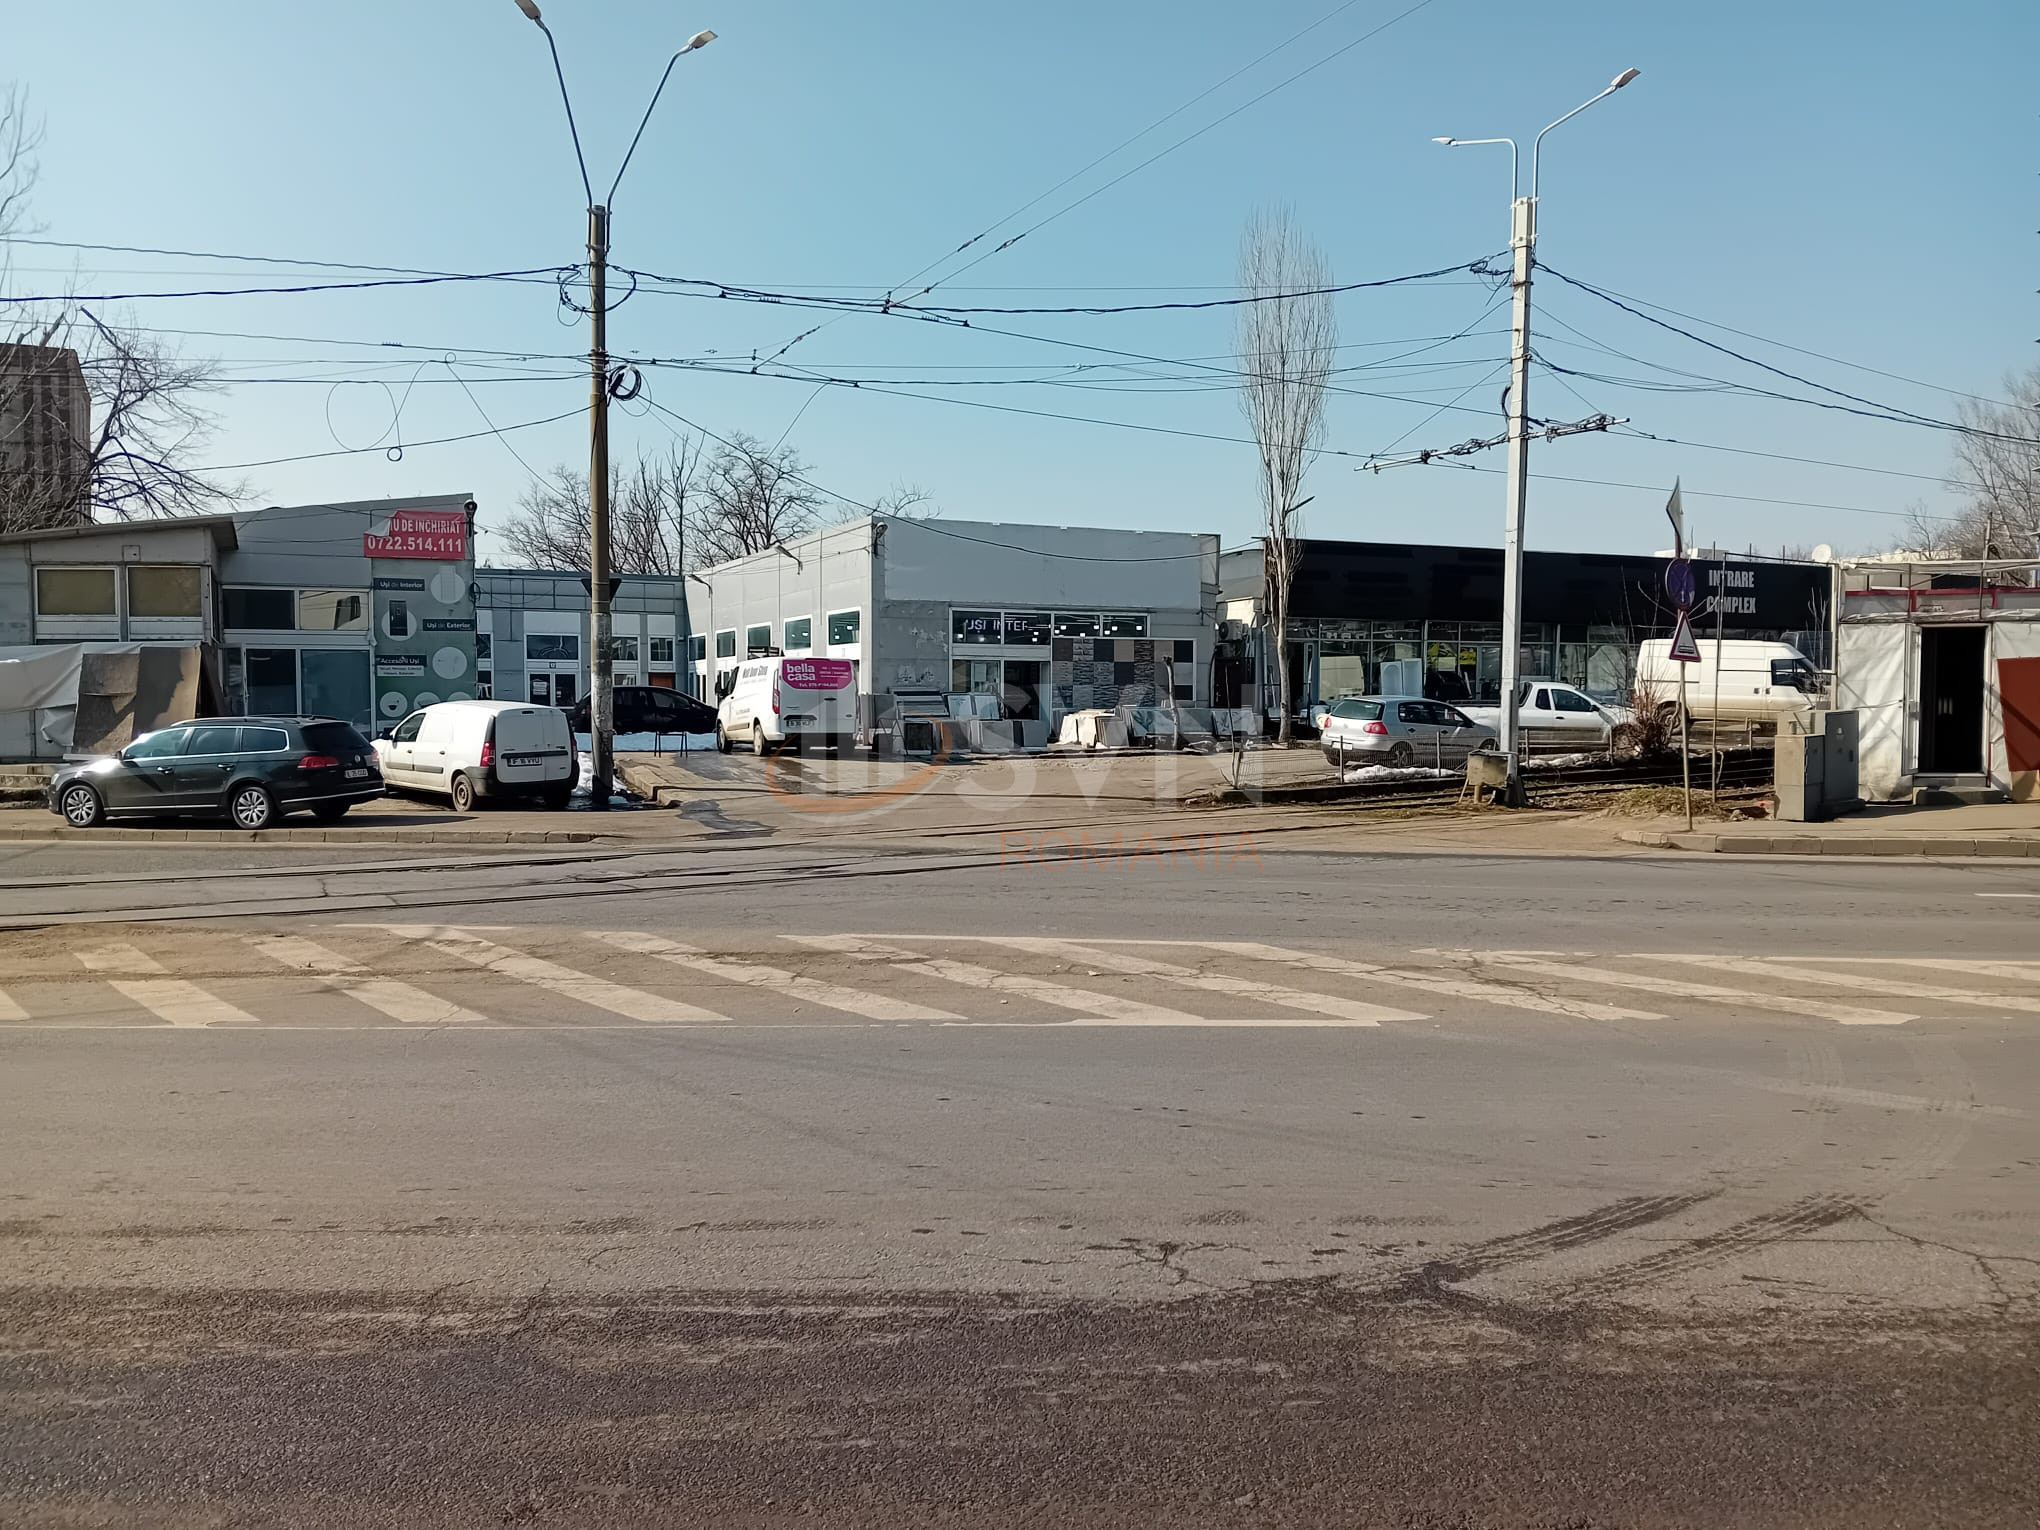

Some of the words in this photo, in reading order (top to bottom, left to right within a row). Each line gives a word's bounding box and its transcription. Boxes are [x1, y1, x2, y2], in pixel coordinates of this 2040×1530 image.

[402, 519, 414, 532] DE
[367, 536, 462, 552] 0722.514.111
[786, 663, 815, 673] bella
[787, 673, 816, 681] casa
